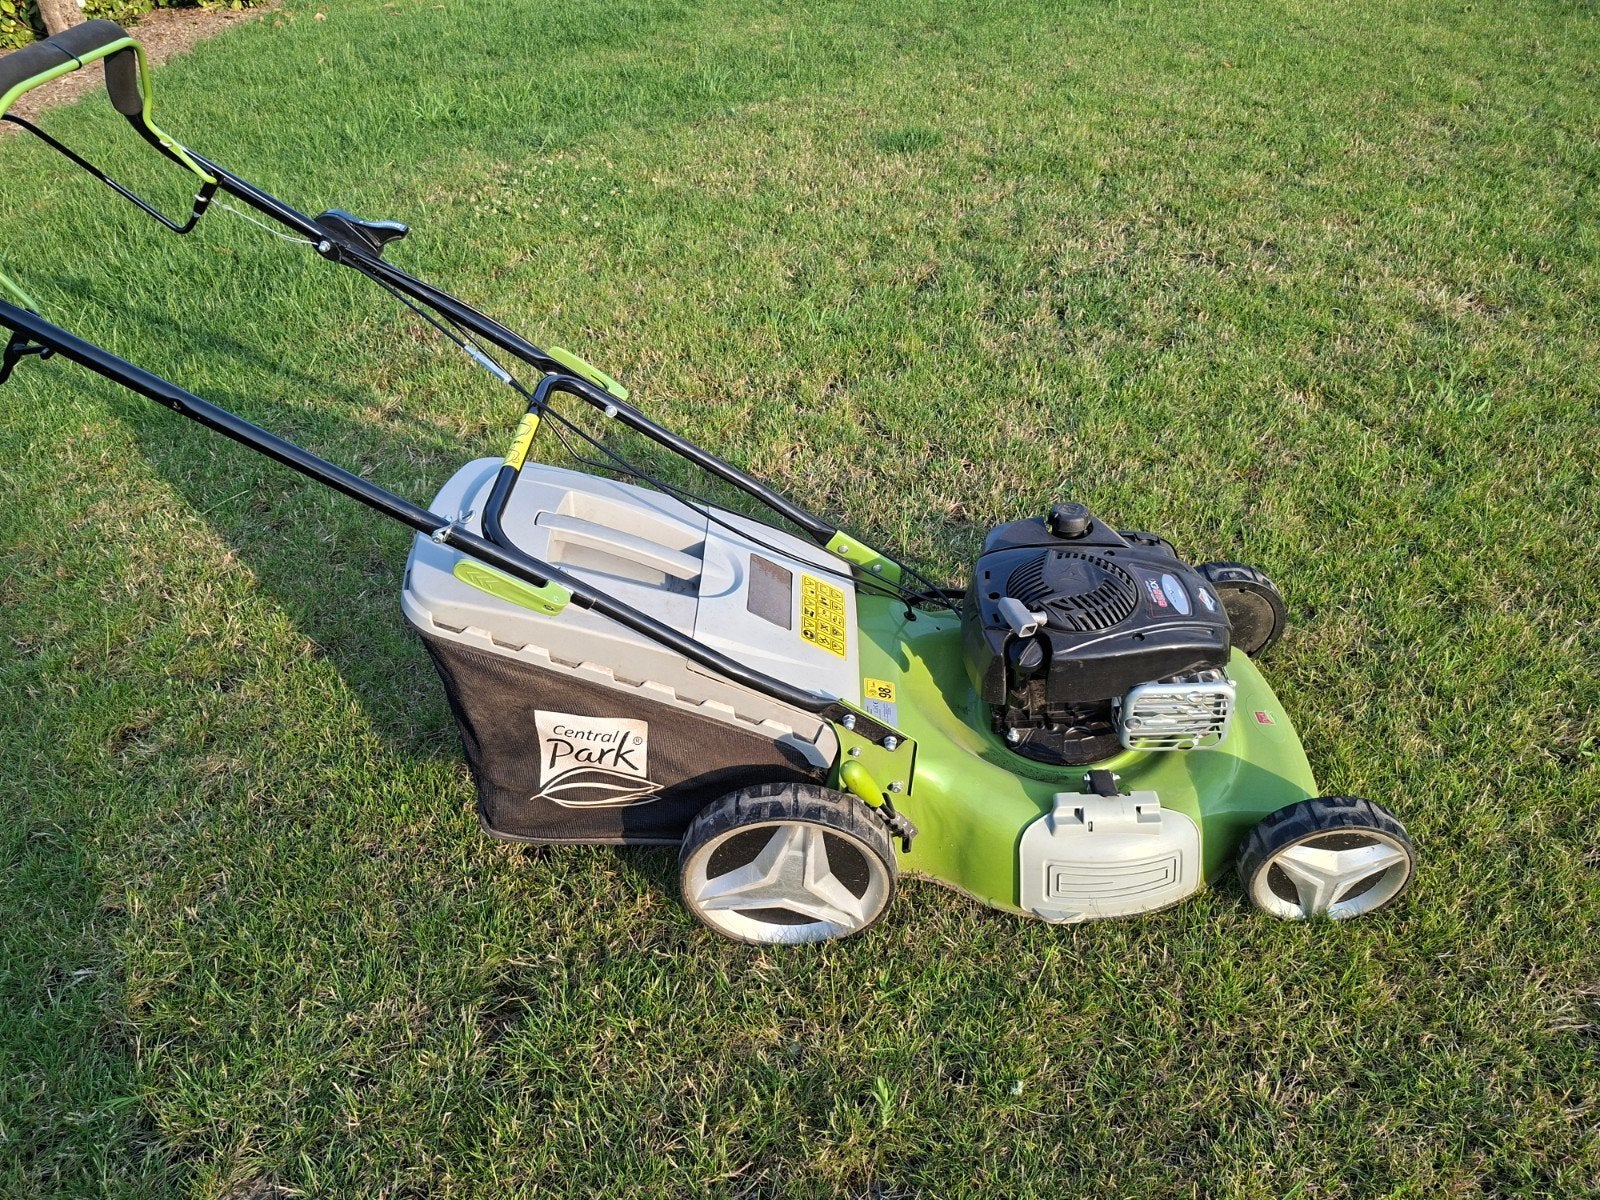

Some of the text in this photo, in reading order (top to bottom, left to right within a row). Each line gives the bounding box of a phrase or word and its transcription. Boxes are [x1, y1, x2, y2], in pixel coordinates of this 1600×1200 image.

[878, 686, 891, 699] 98
[553, 725, 620, 743] Central
[546, 731, 639, 770] Park
